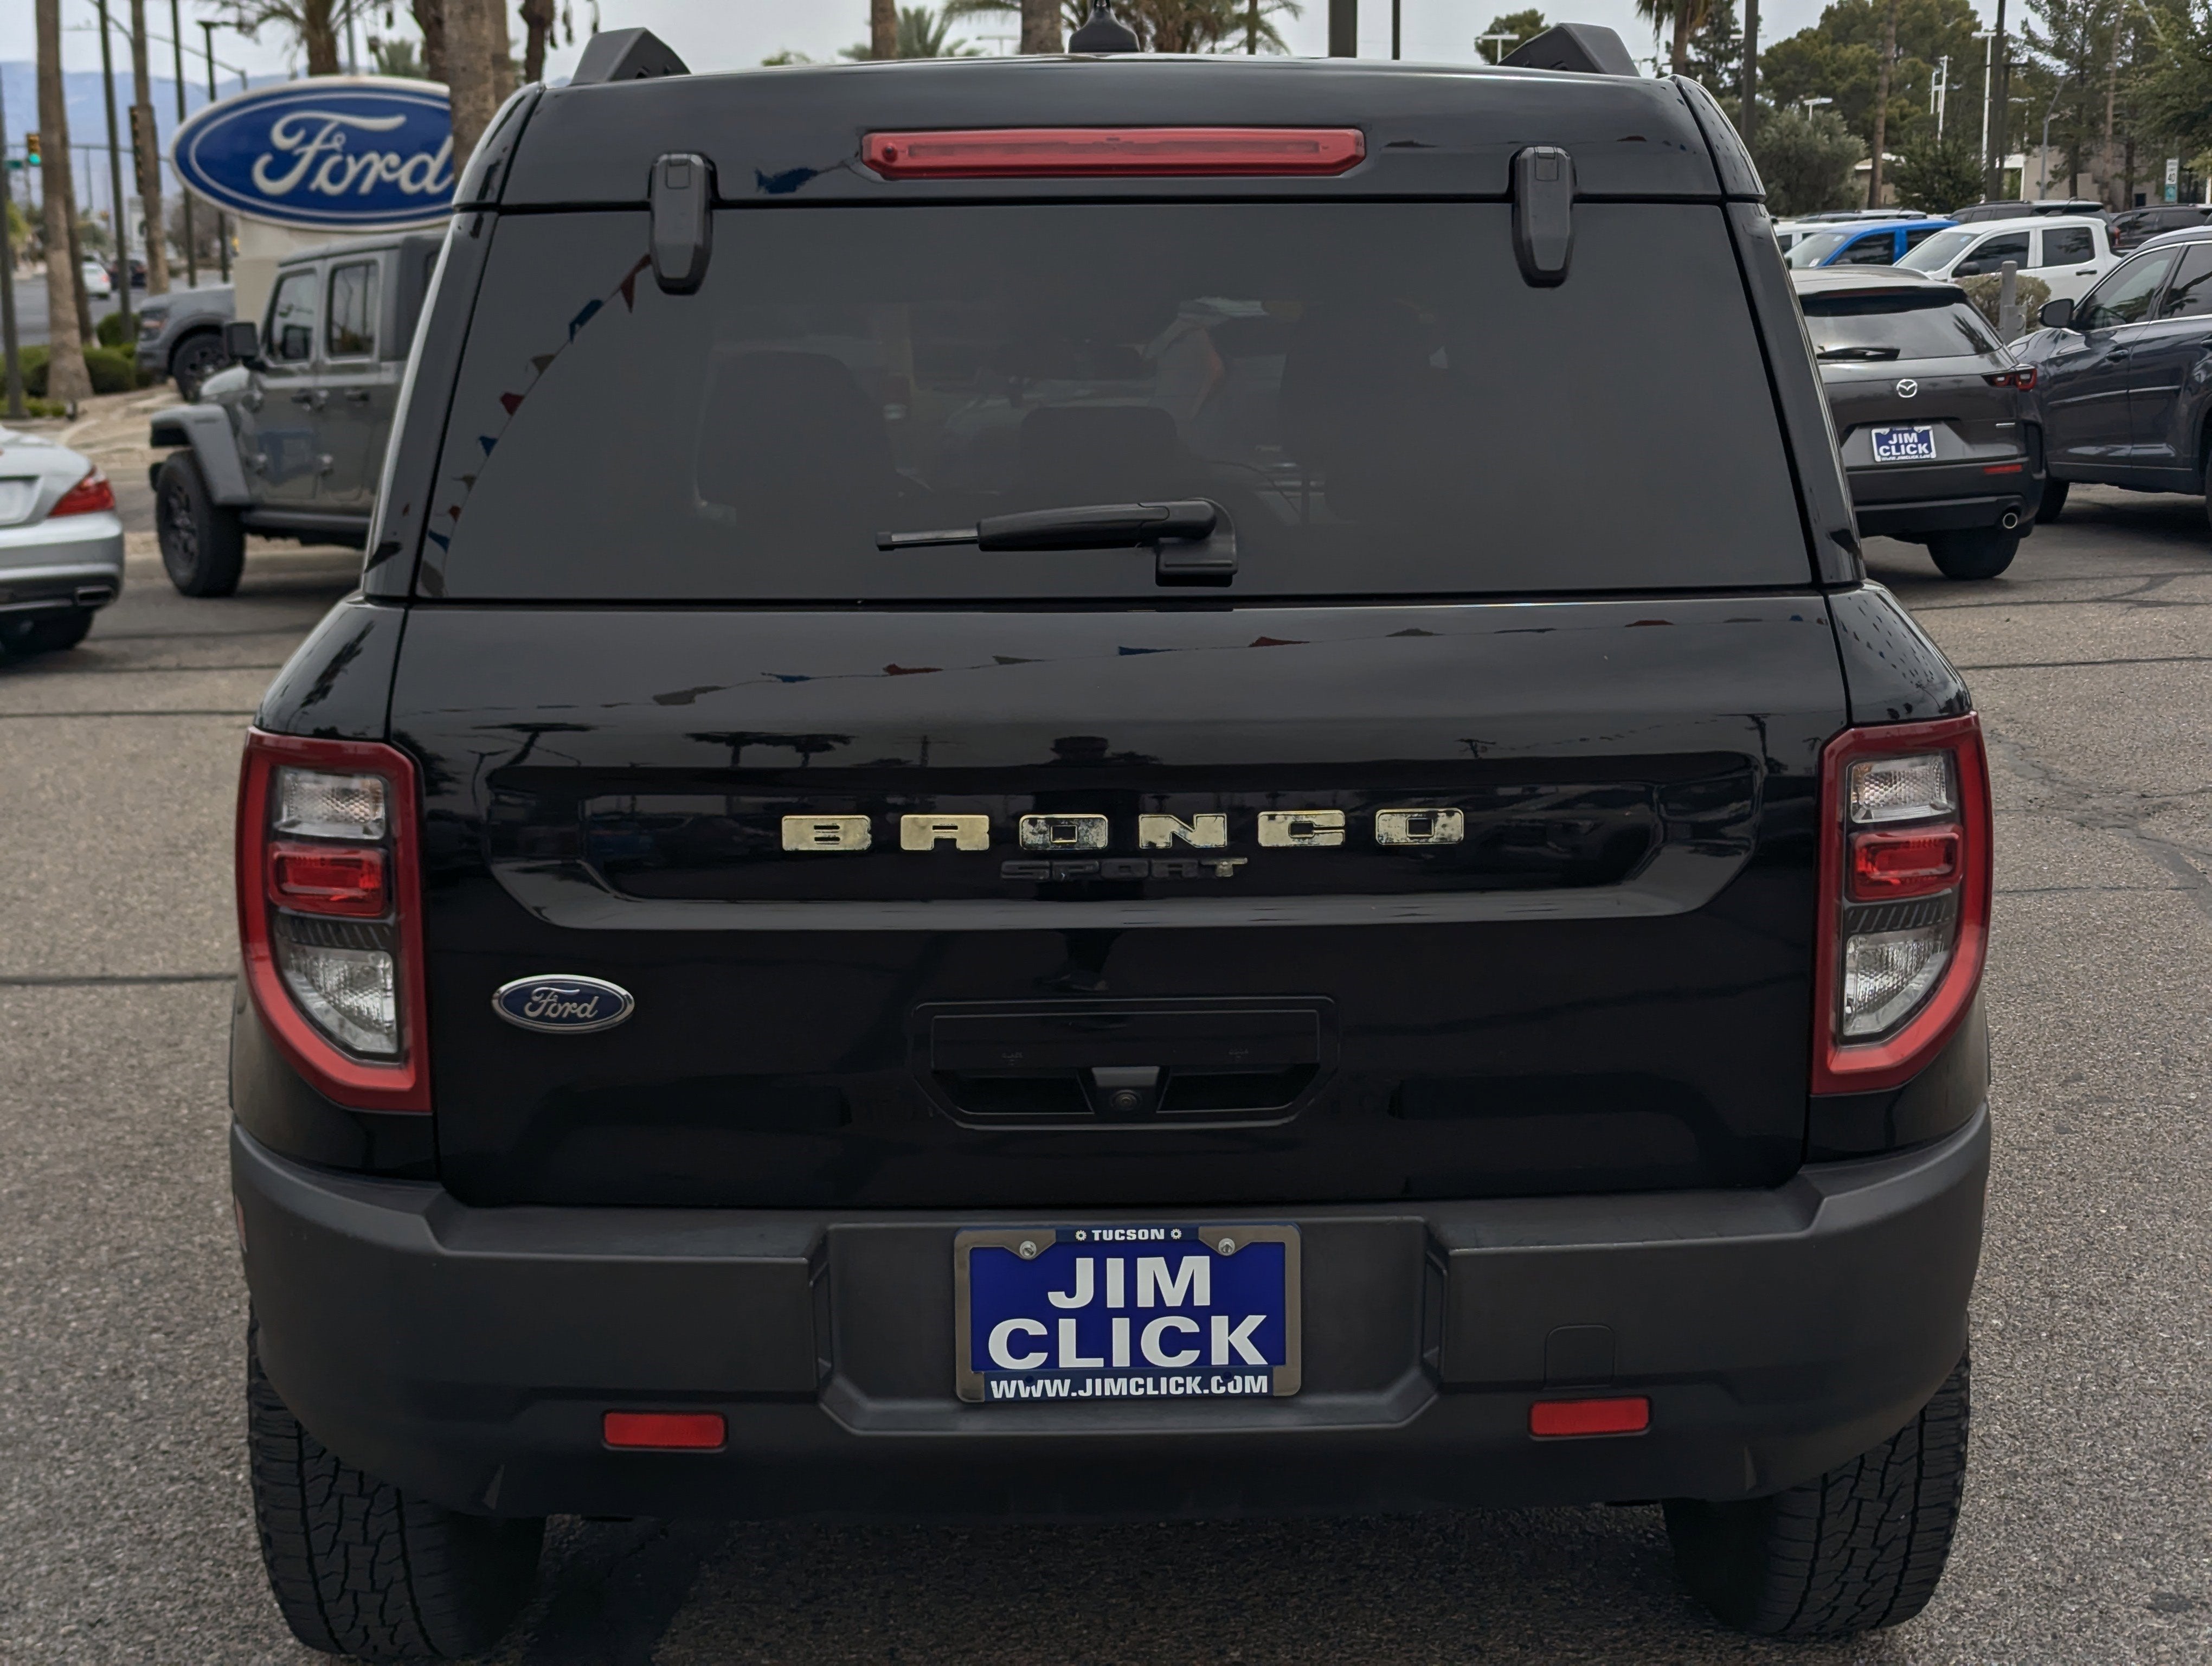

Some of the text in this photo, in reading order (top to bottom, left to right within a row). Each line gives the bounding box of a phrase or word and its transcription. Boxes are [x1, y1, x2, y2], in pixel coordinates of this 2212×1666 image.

[252, 110, 454, 195] Ford
[1879, 443, 1929, 456] CLICK
[1888, 433, 1918, 444] JIM
[782, 808, 1464, 851] BRONCO
[1001, 857, 1248, 881] SPORT
[524, 986, 599, 1018] Ford
[1091, 1228, 1165, 1241] TUCSON
[1047, 1255, 1211, 1309] JIM
[988, 1314, 1268, 1370] CLICK
[991, 1375, 1268, 1399] WWW.JIMCLICK.COM
